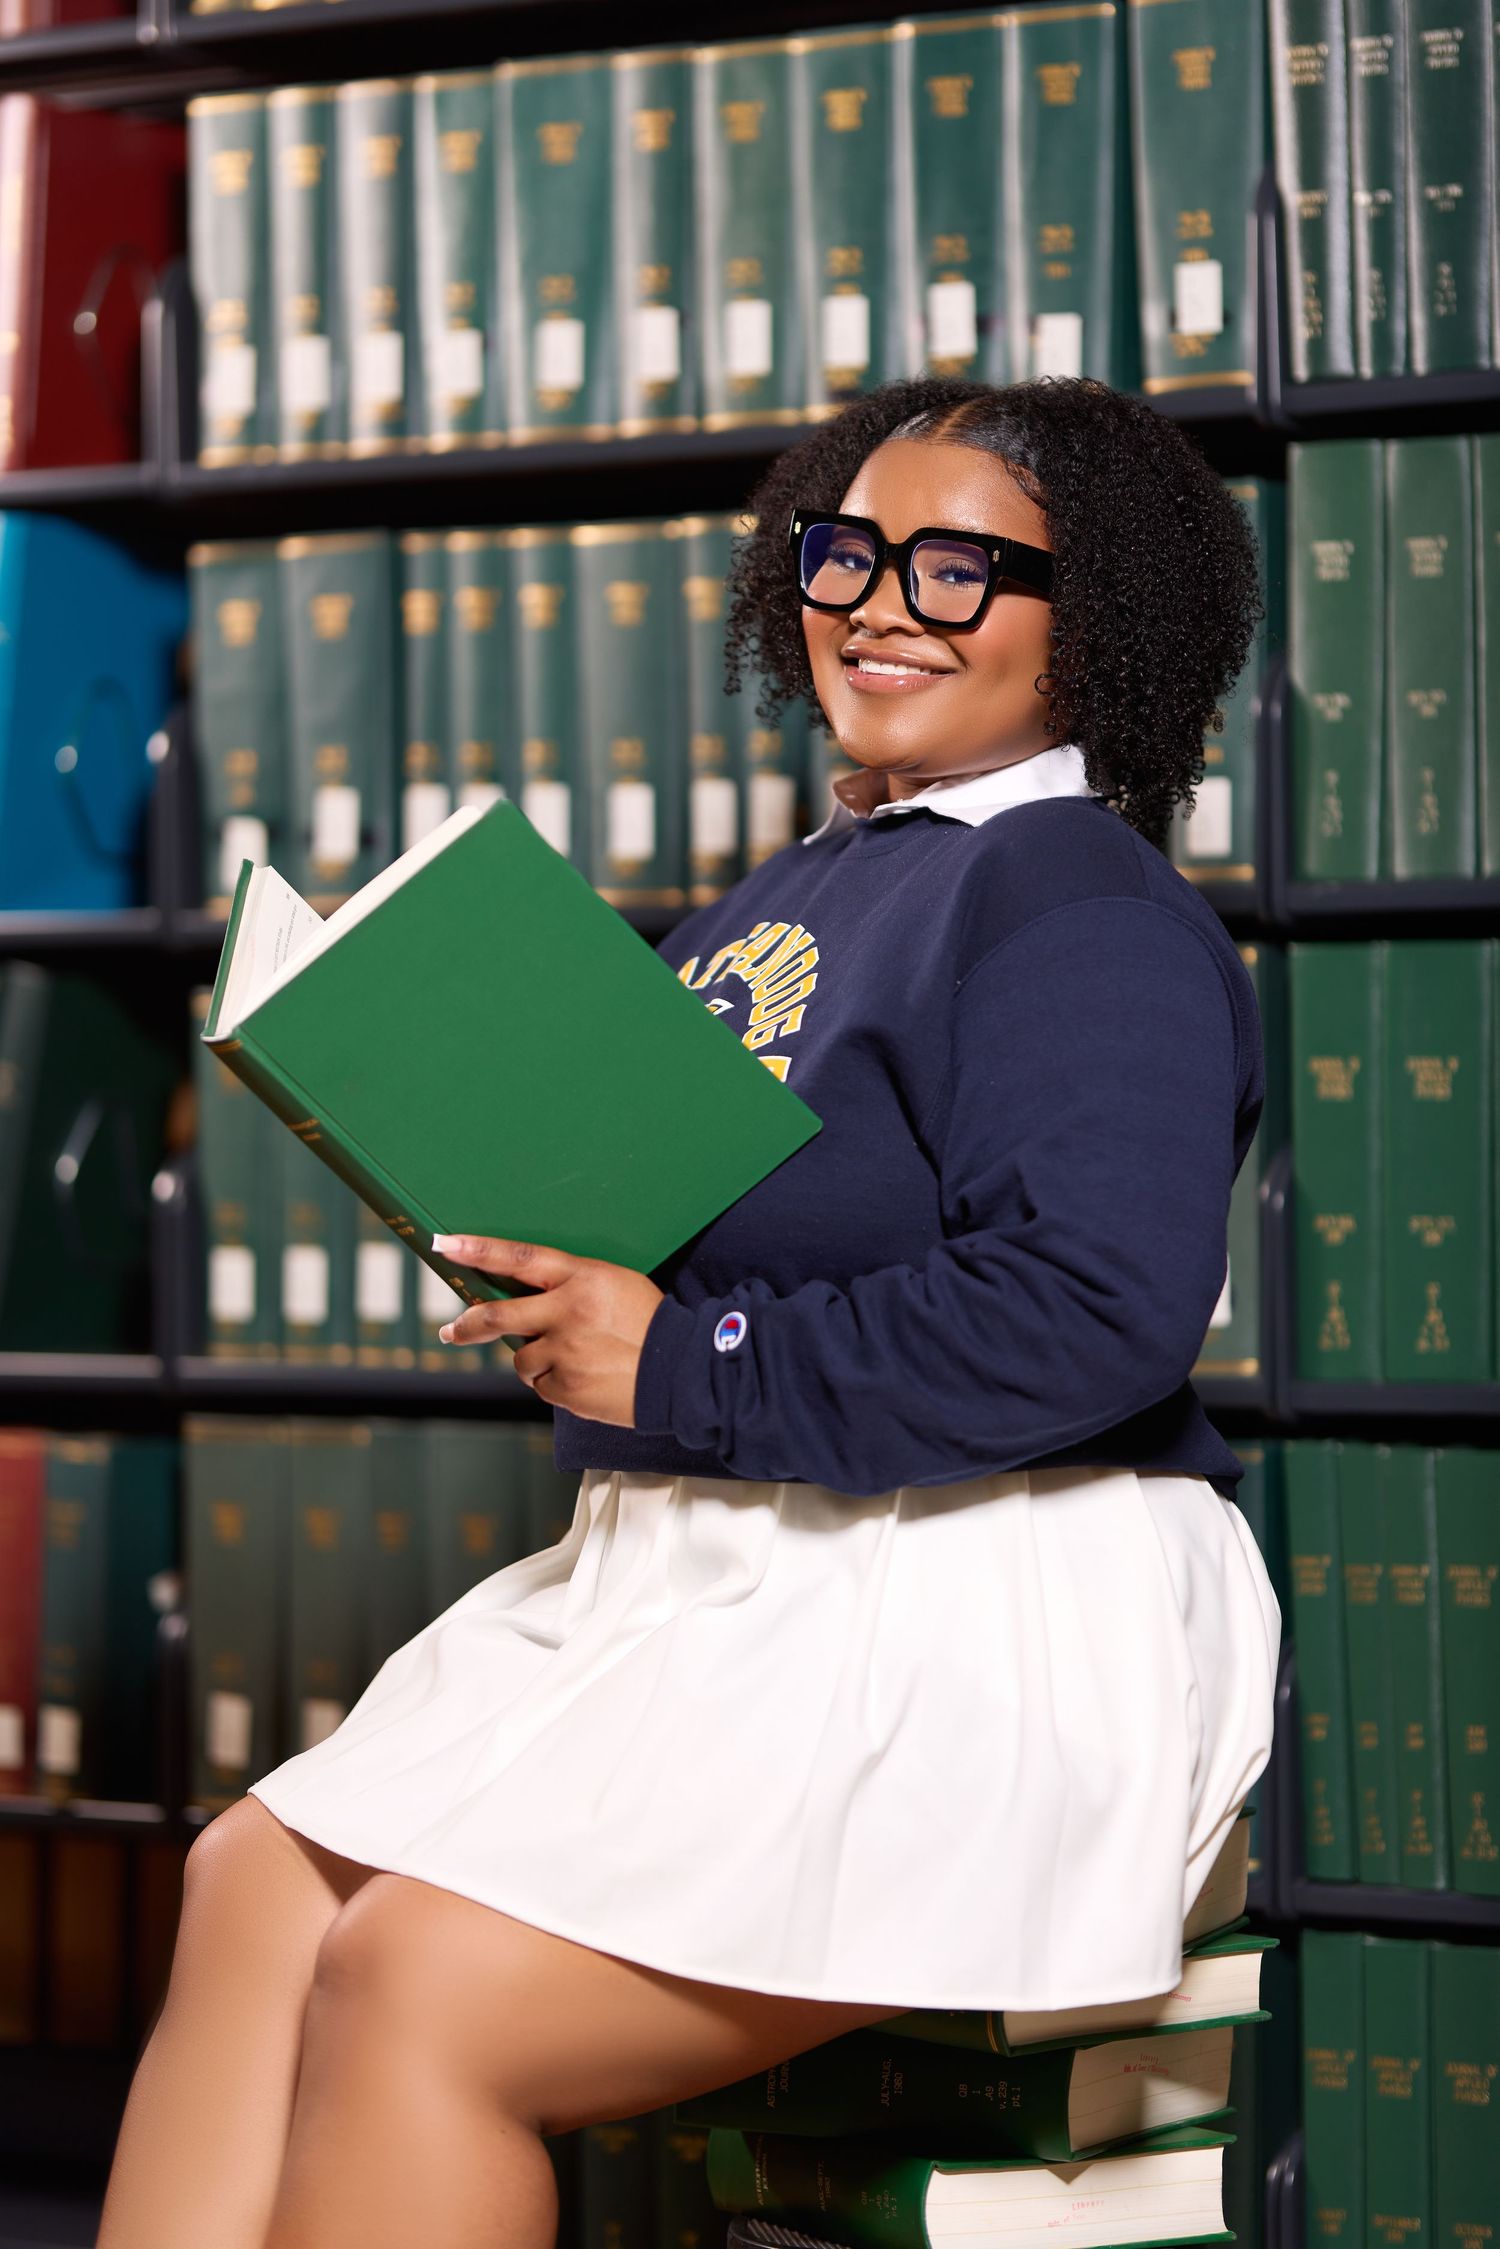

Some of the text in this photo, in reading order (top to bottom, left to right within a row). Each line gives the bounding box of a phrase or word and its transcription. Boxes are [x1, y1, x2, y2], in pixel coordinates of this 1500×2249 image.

[880, 2058, 892, 2107] JULY-AUG.
[893, 2072, 903, 2095] 1980
[958, 2083, 968, 2098] QB
[998, 2080, 1007, 2098] 239
